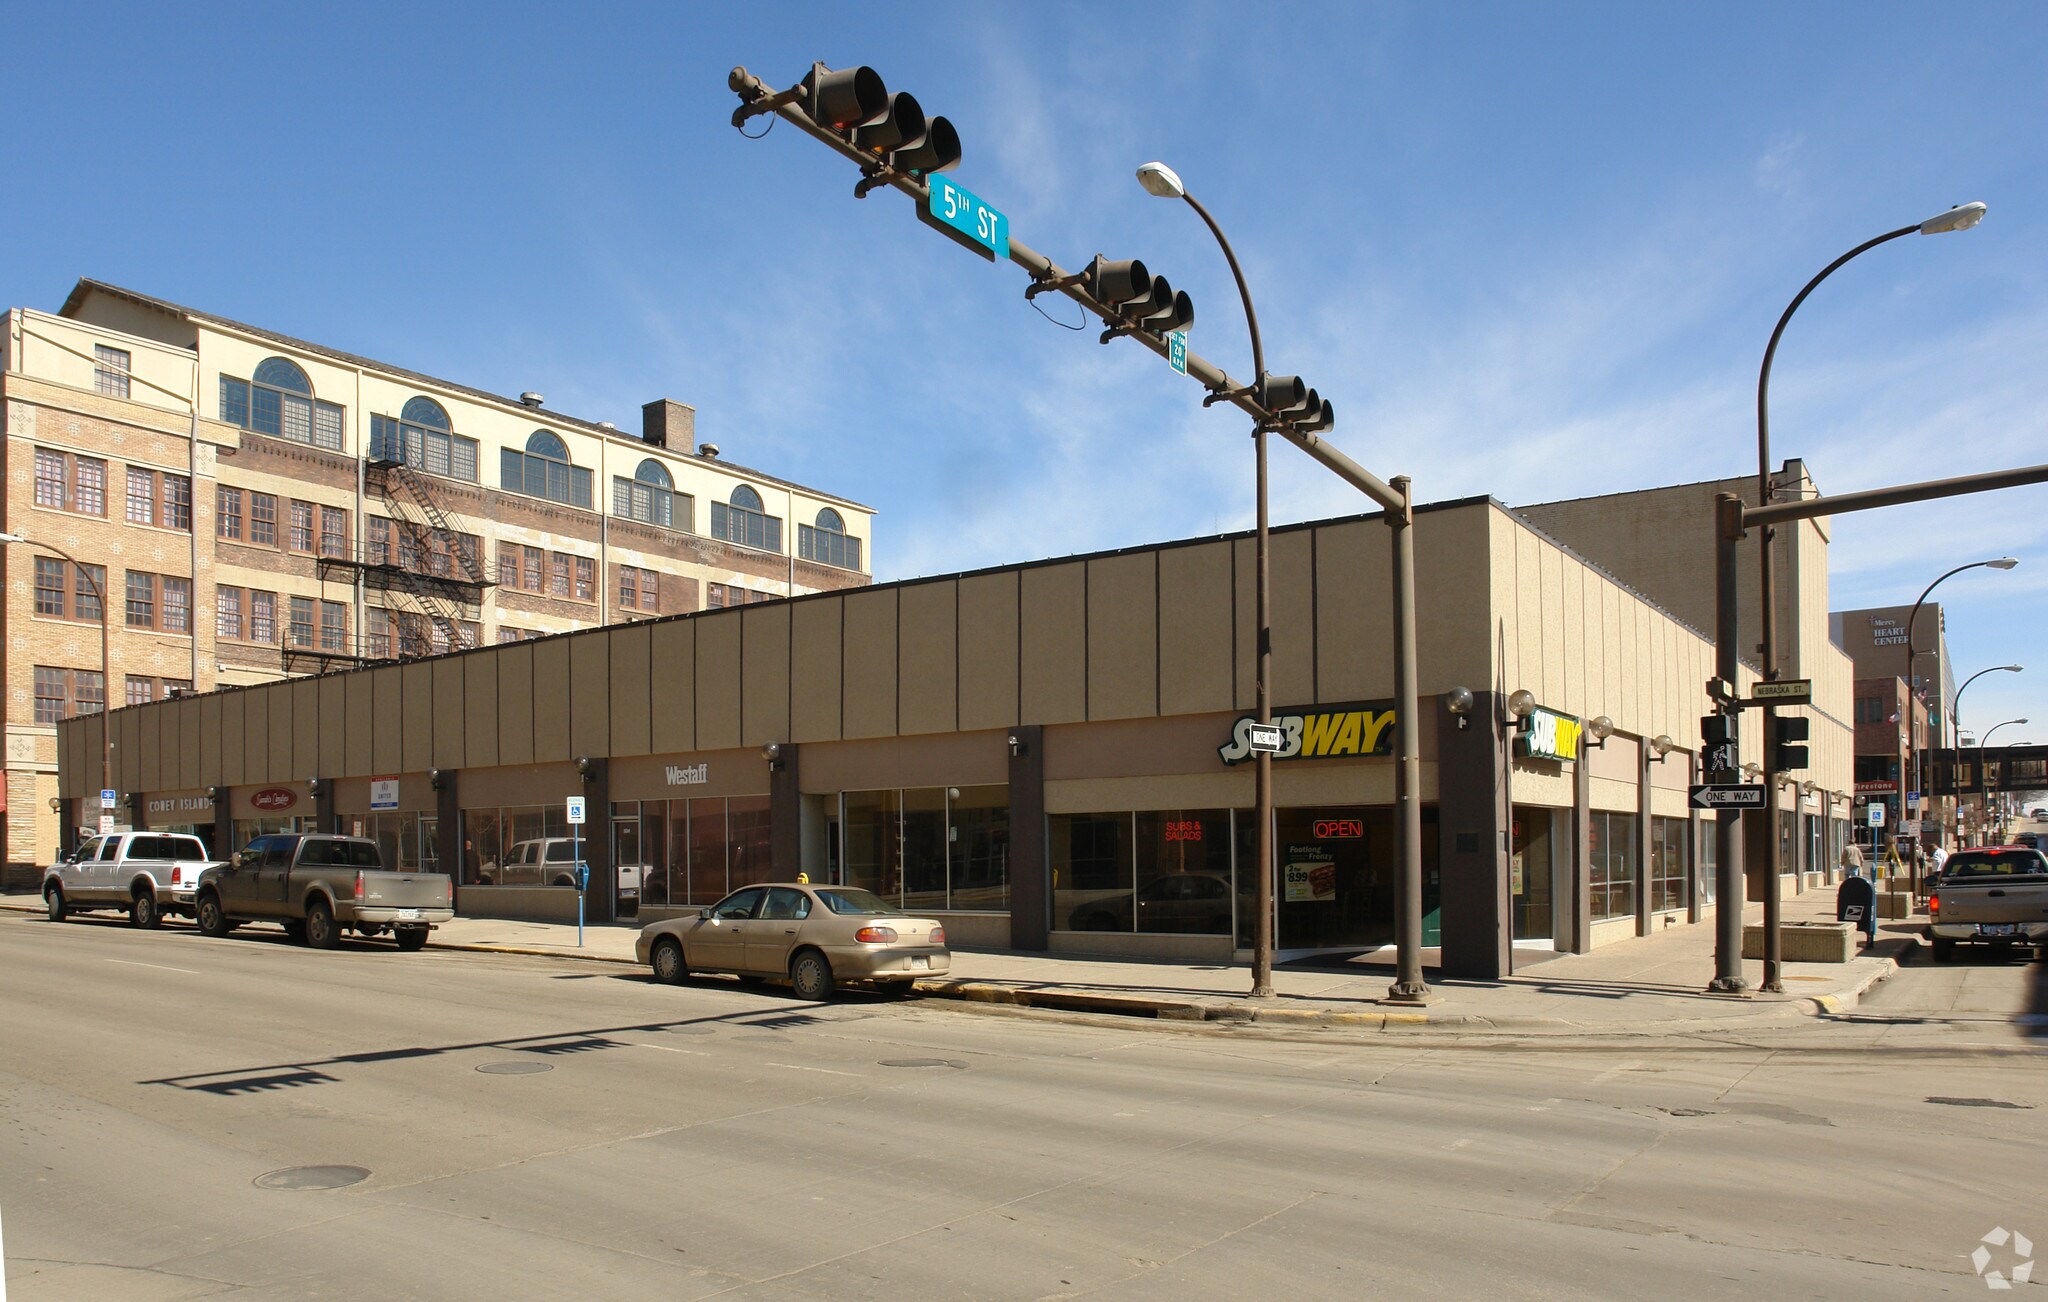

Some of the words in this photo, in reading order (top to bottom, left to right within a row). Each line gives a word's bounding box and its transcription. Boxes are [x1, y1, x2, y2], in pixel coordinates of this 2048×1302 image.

[944, 184, 970, 219] 5TH
[977, 206, 998, 245] ST
[1174, 343, 1183, 357] 20
[1874, 619, 1896, 627] Mercy
[1874, 627, 1905, 637] HEART
[1758, 686, 1790, 695] NEBRASKA
[1256, 732, 1267, 743] ONE
[1529, 709, 1583, 760] SUBWAY
[665, 763, 708, 786] Westaff
[1706, 791, 1727, 802] ONE
[1733, 791, 1756, 801] WAY
[149, 799, 176, 812] CONEY
[180, 797, 210, 810] ISLAND
[1166, 821, 1192, 831] SUBS
[1194, 821, 1201, 830] &
[1315, 821, 1361, 838] OPEN
[1165, 831, 1202, 841] SALADS
[1289, 846, 1322, 854] Footlong
[1308, 853, 1334, 861] Frenzy
